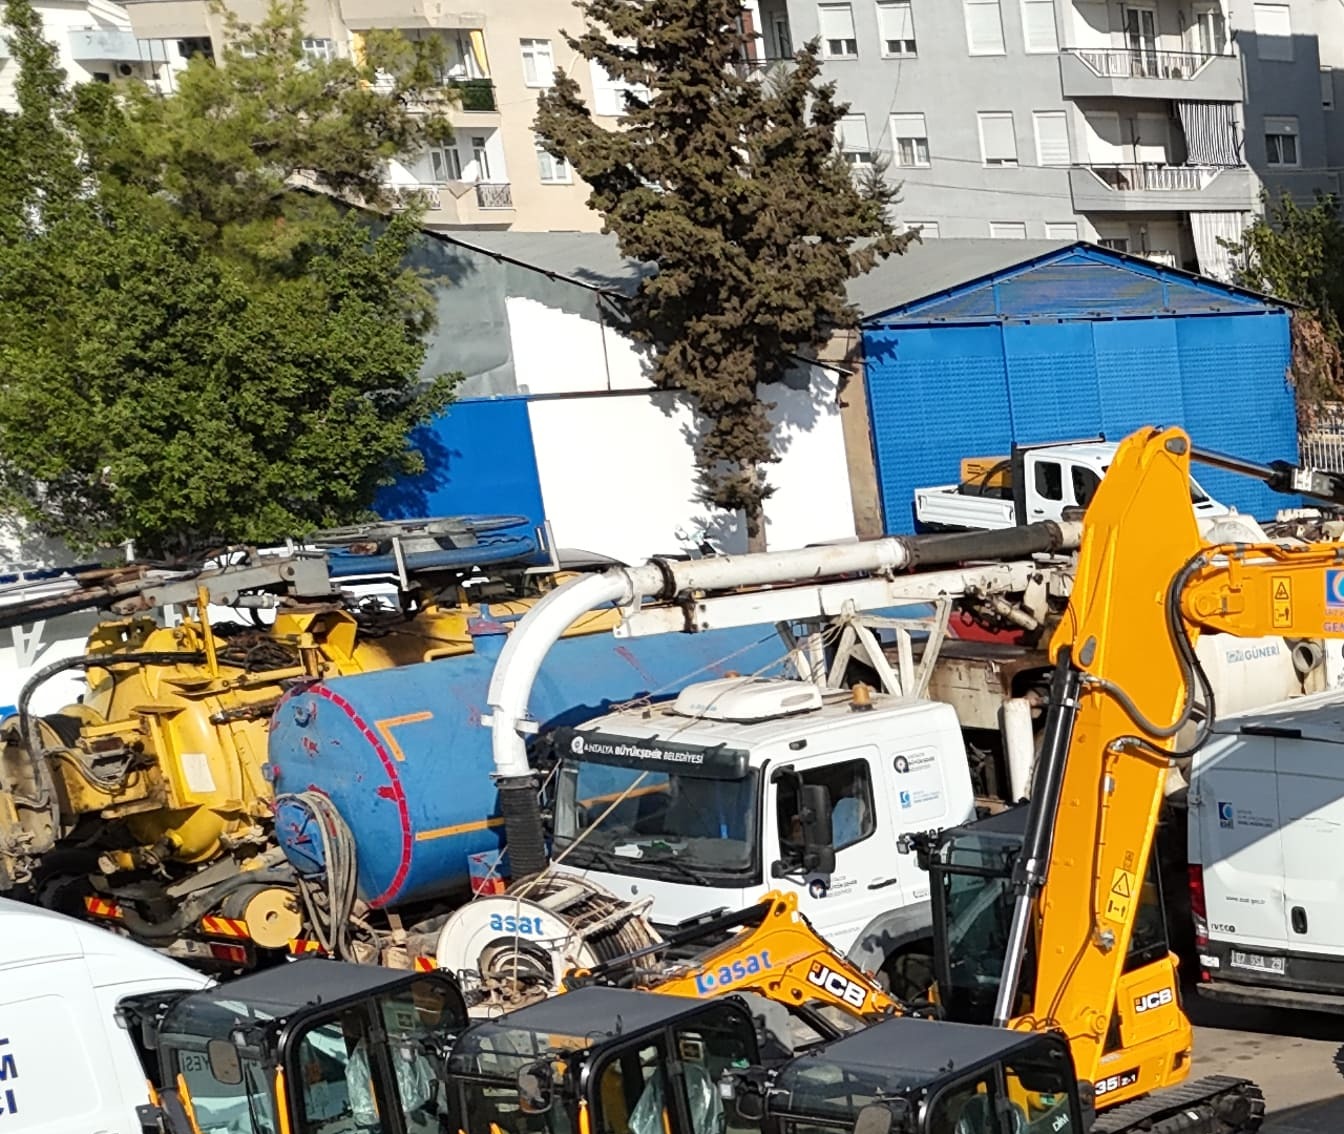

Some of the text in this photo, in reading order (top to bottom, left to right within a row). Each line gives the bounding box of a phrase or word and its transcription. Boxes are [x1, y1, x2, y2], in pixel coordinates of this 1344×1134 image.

[1245, 644, 1280, 660] GÜNERİ
[489, 910, 544, 936] asat
[718, 949, 772, 985] asat
[808, 965, 867, 1006] JCB
[1135, 987, 1174, 1014] JCB
[1095, 1076, 1118, 1095] 35
